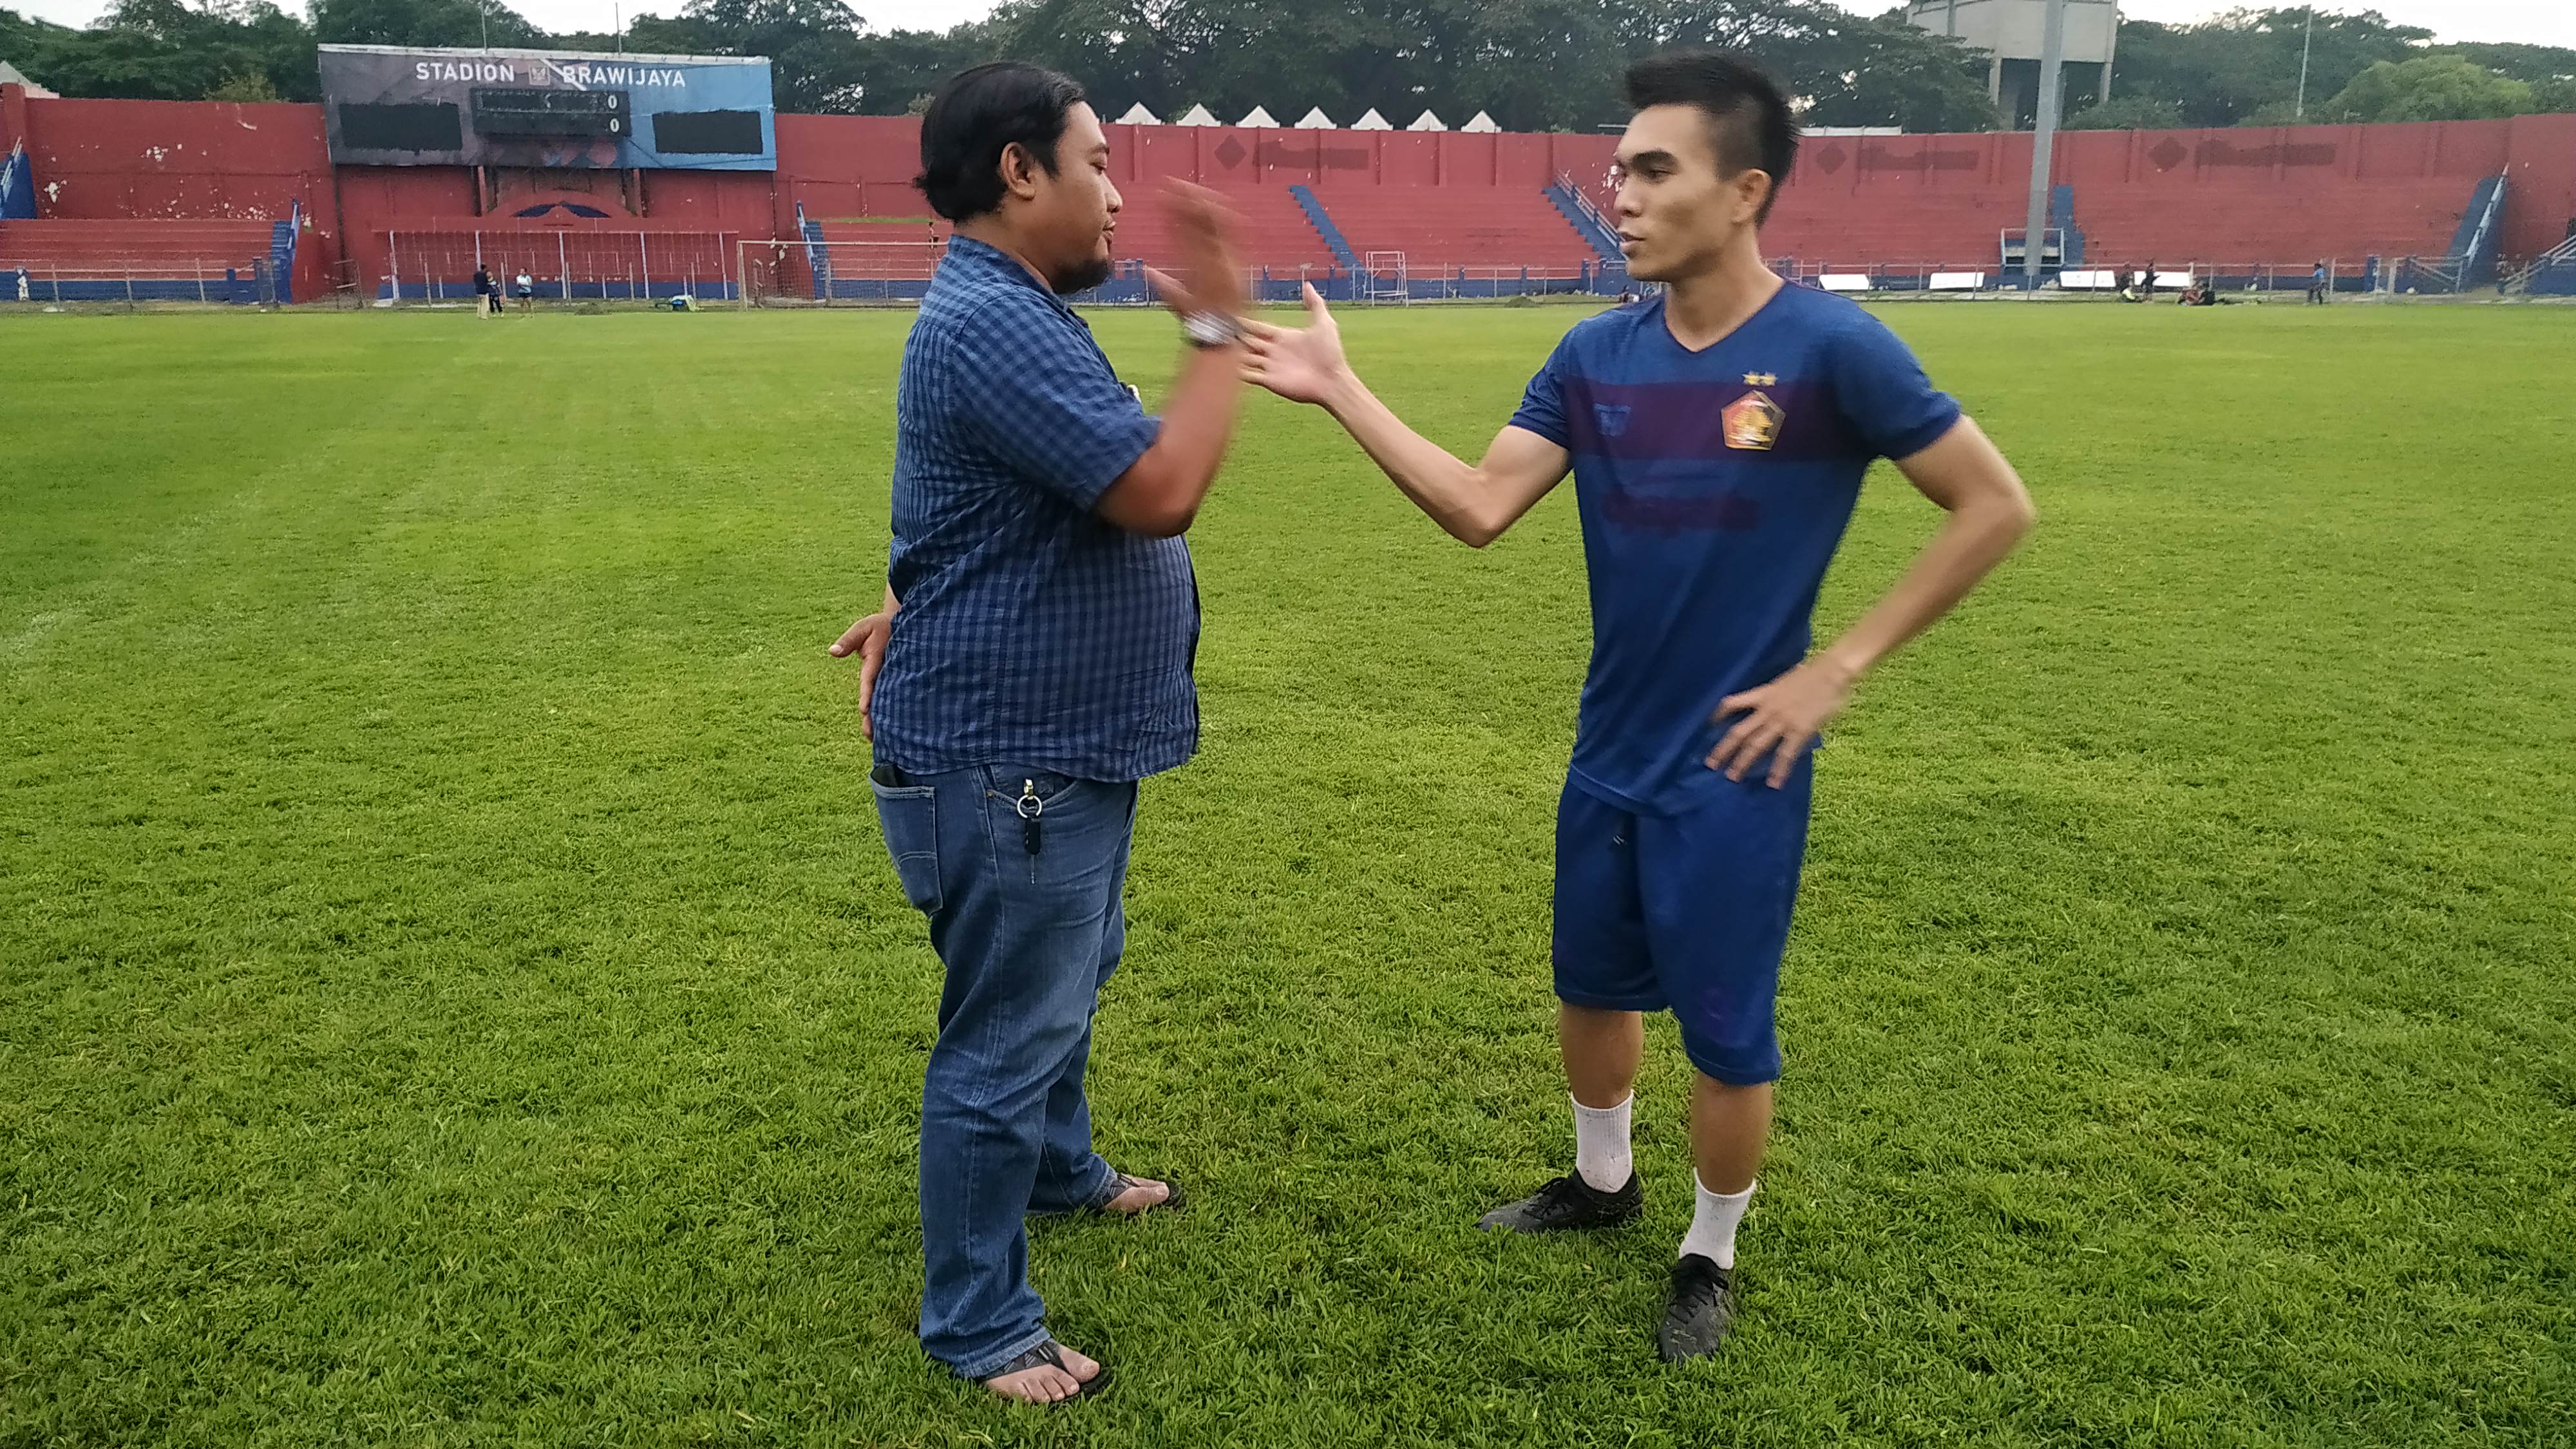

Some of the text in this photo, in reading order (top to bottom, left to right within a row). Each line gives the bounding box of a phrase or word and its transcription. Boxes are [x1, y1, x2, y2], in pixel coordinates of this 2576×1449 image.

[416, 62, 686, 87] STADION BRAWIJAYA
[607, 95, 618, 109] 0
[609, 118, 620, 133] 0
